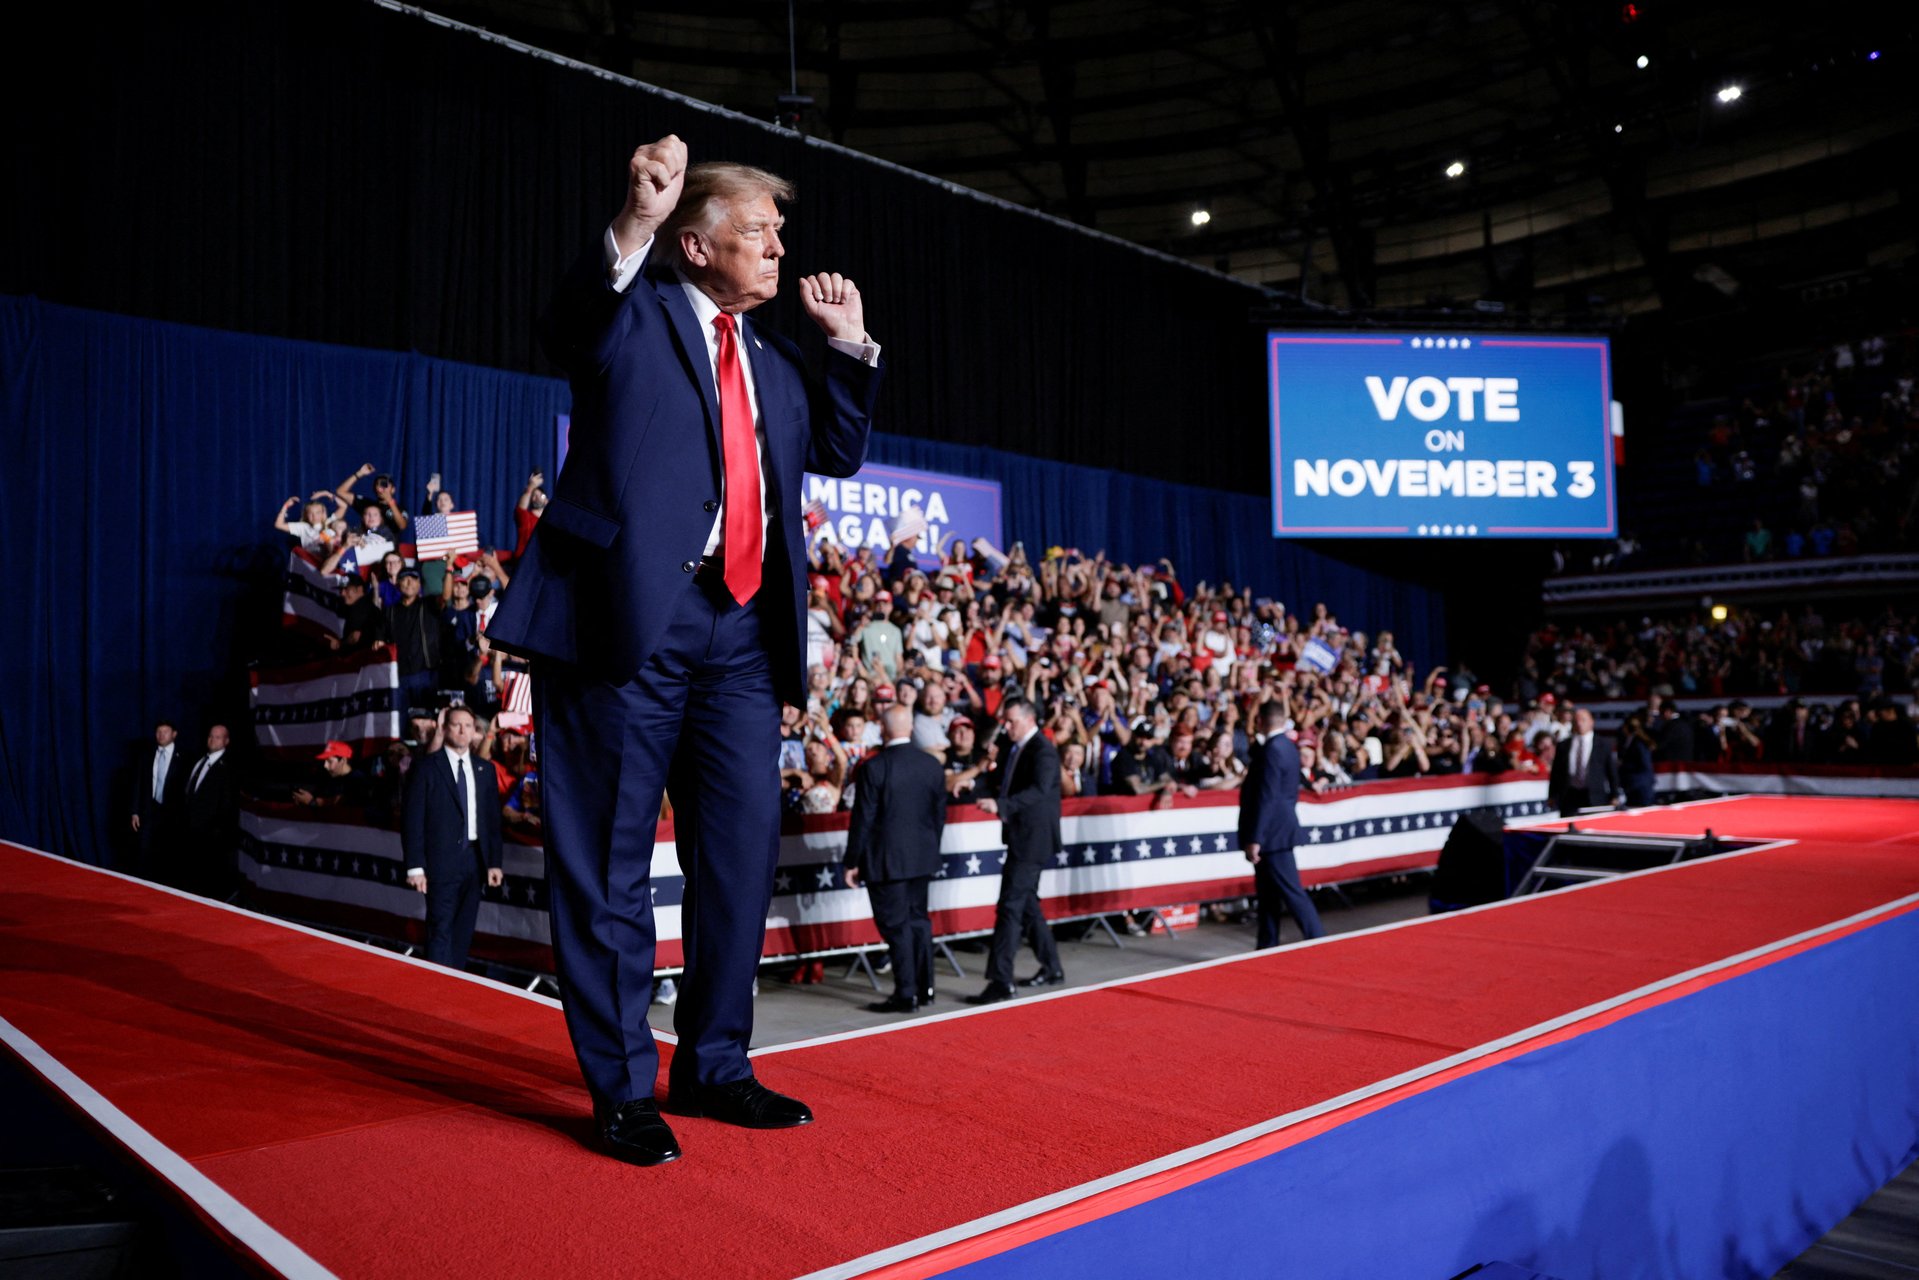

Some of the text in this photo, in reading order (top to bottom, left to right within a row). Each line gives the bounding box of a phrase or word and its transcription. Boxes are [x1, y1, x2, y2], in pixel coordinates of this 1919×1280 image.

[1365, 376, 1520, 422] VOTE
[1425, 429, 1465, 452] ON
[1294, 458, 1596, 498] NOVEMBER 3
[801, 476, 949, 524] MERICA
[813, 514, 940, 555] AGA!
